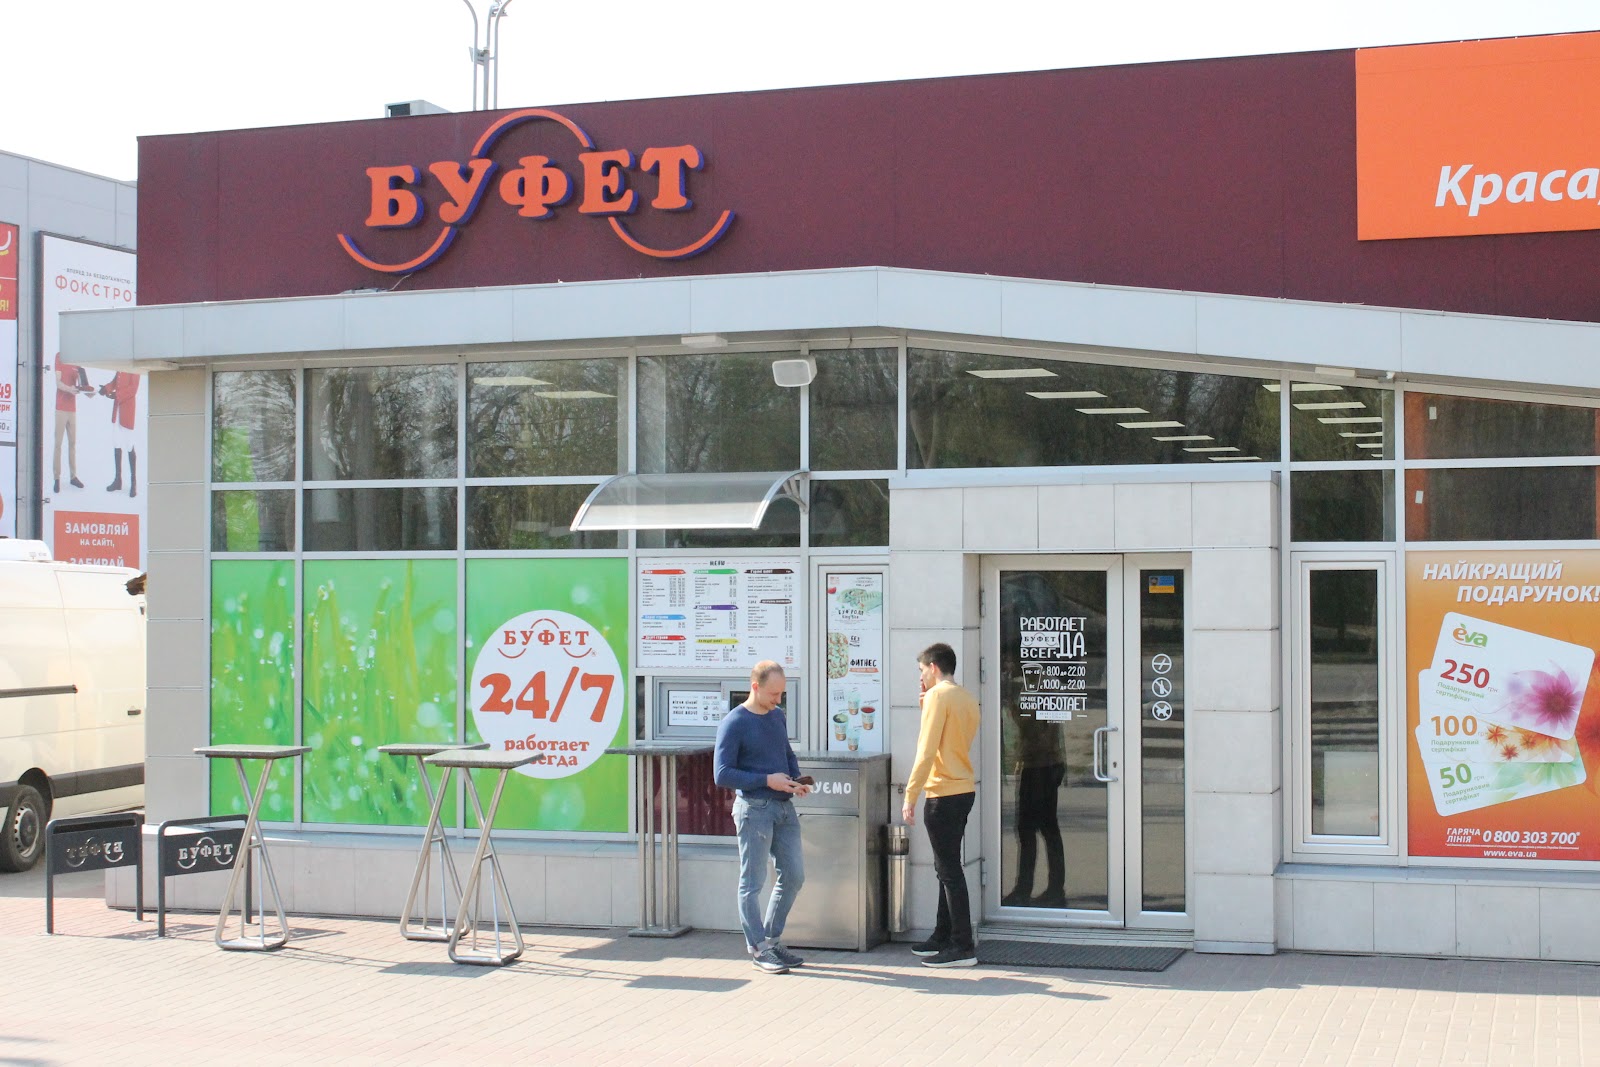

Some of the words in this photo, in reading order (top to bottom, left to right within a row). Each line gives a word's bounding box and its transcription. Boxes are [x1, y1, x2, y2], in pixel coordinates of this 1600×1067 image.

[365, 144, 705, 230] БУФЕТ
[1434, 163, 1600, 217] Краса
[55, 274, 136, 303] ФОКСТРО
[64, 521, 129, 536] ЗАМОВЛЯЙ
[80, 538, 90, 546] НА
[1422, 559, 1563, 584] НАЙКРАЩИЙ
[1456, 585, 1600, 606] ПОДАРУНОК!
[1019, 616, 1087, 631] РАБОТАЕТ
[503, 629, 590, 646] БУФЕТ
[850, 658, 877, 668] ФИТНЕС
[1046, 665, 1060, 676] 8.00
[1067, 665, 1086, 677] 22.00
[1440, 658, 1490, 689] 250
[1043, 678, 1060, 690] 10.00
[1067, 679, 1086, 690] 22.00
[1437, 681, 1485, 699] Подарунковий
[479, 666, 615, 723] 24/7
[1435, 689, 1471, 702] сертифікат
[1020, 702, 1037, 710] ОКНО
[1037, 696, 1087, 711] РАБОТАЕТ
[1430, 715, 1478, 737] 100
[504, 733, 590, 752] работает
[1439, 763, 1472, 789] 50
[809, 780, 852, 795] УЄМО
[1446, 827, 1481, 836] ГАРЯЧА
[1482, 830, 1492, 843] 0
[1493, 830, 1520, 843] 800
[1521, 831, 1548, 844] 303
[1446, 835, 1472, 843] ЛІНІЯ
[178, 843, 234, 861] БУФЕТ
[1483, 849, 1538, 858] www.eva.ua
